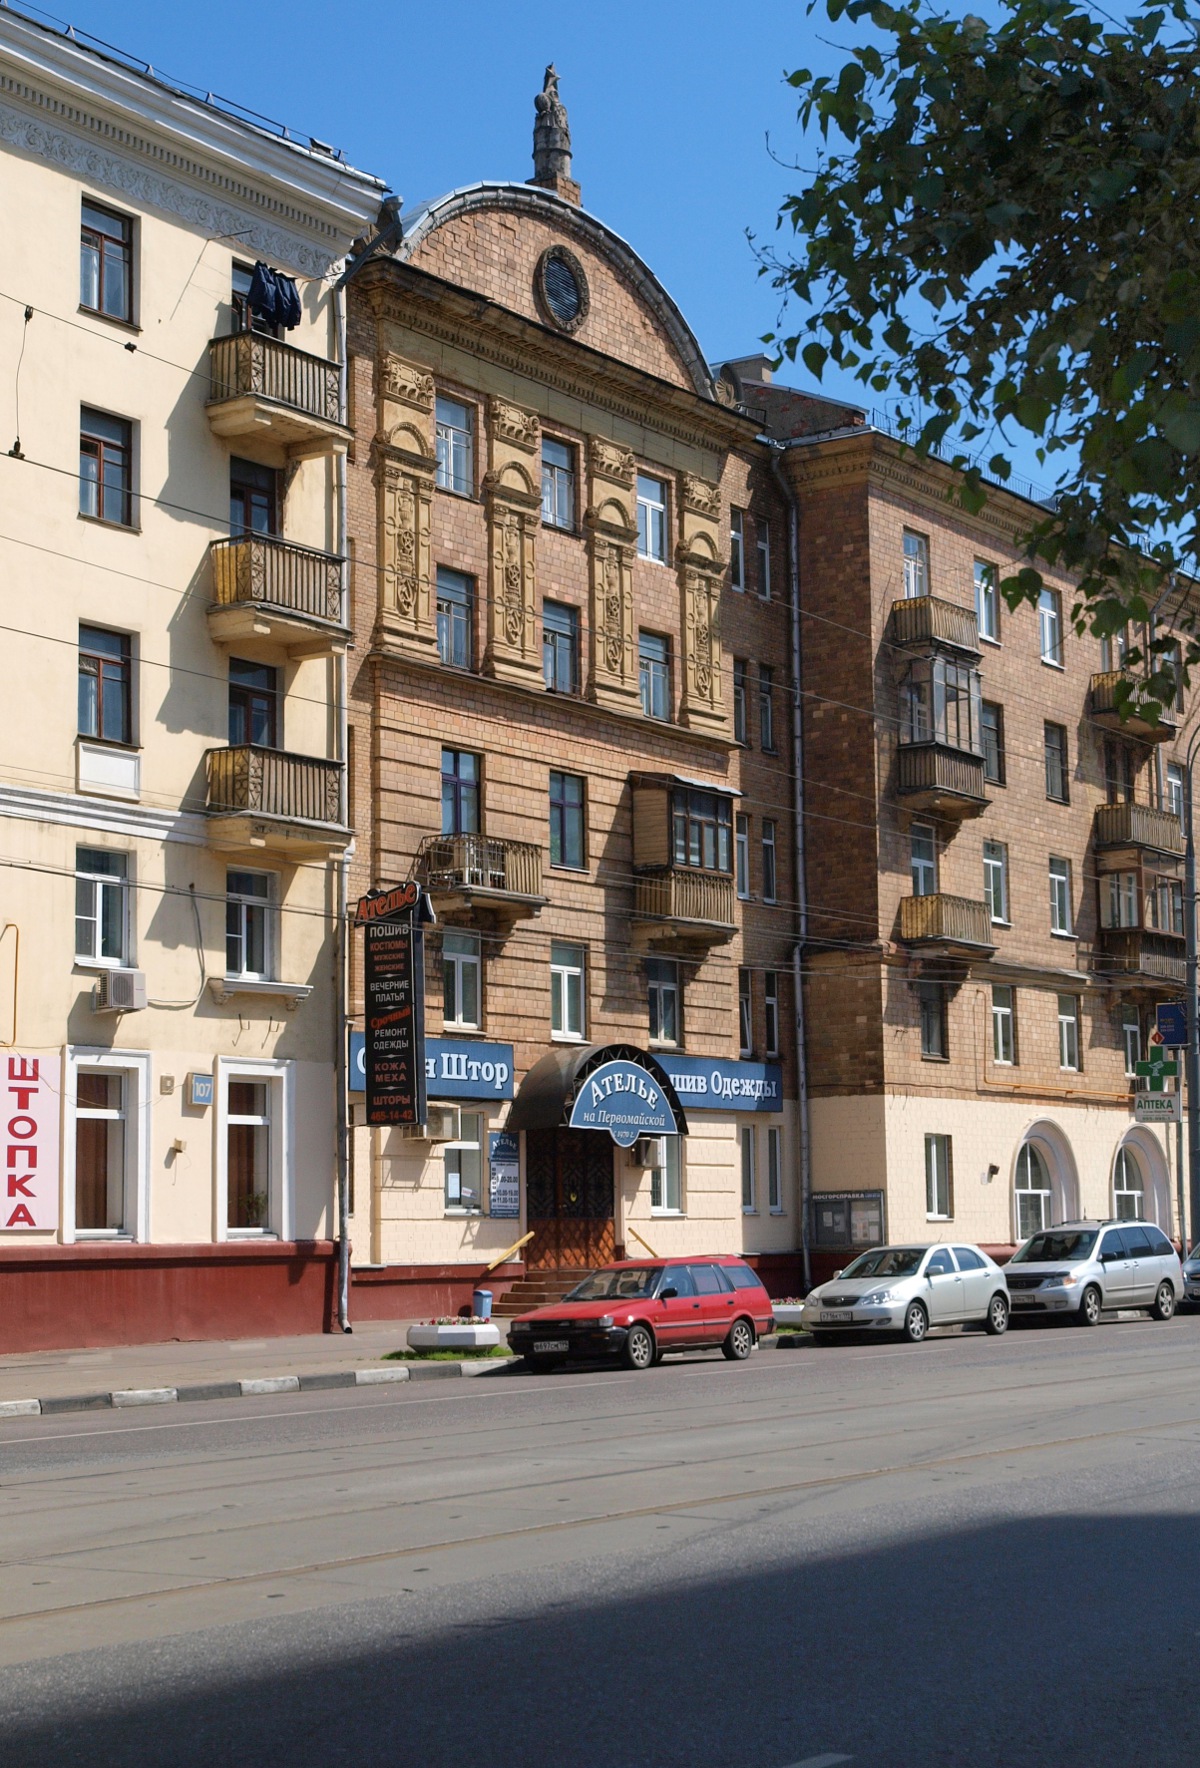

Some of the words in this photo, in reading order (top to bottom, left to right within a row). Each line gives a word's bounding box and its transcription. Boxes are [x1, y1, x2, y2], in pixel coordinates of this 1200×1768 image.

[357, 884, 416, 920] Ателье
[370, 924, 409, 937] ПОШИВ
[370, 940, 408, 951] КОСТЮМЫ
[374, 963, 405, 971] ЖЕНСКИЕ
[370, 980, 410, 991] ВЕЧЕРНИЕ
[375, 992, 405, 1002] ПЛАТЬЯ
[374, 1028, 408, 1037] РЕМОНТ
[373, 1040, 409, 1050] ОДЕЖДЫ
[375, 1062, 407, 1071] КОЖА
[441, 1053, 508, 1089] Штор
[375, 1073, 407, 1082] МЕХА
[196, 1083, 211, 1097] 107
[711, 1071, 777, 1101] Одежды
[373, 1095, 410, 1105] ШТОРЫ
[1137, 1100, 1173, 1109] АПТЕКА
[371, 1110, 413, 1120] 465-14-42
[583, 1112, 595, 1122] на
[597, 1110, 665, 1126] Первомайской
[6, 1057, 39, 1227] ШТОПКА
